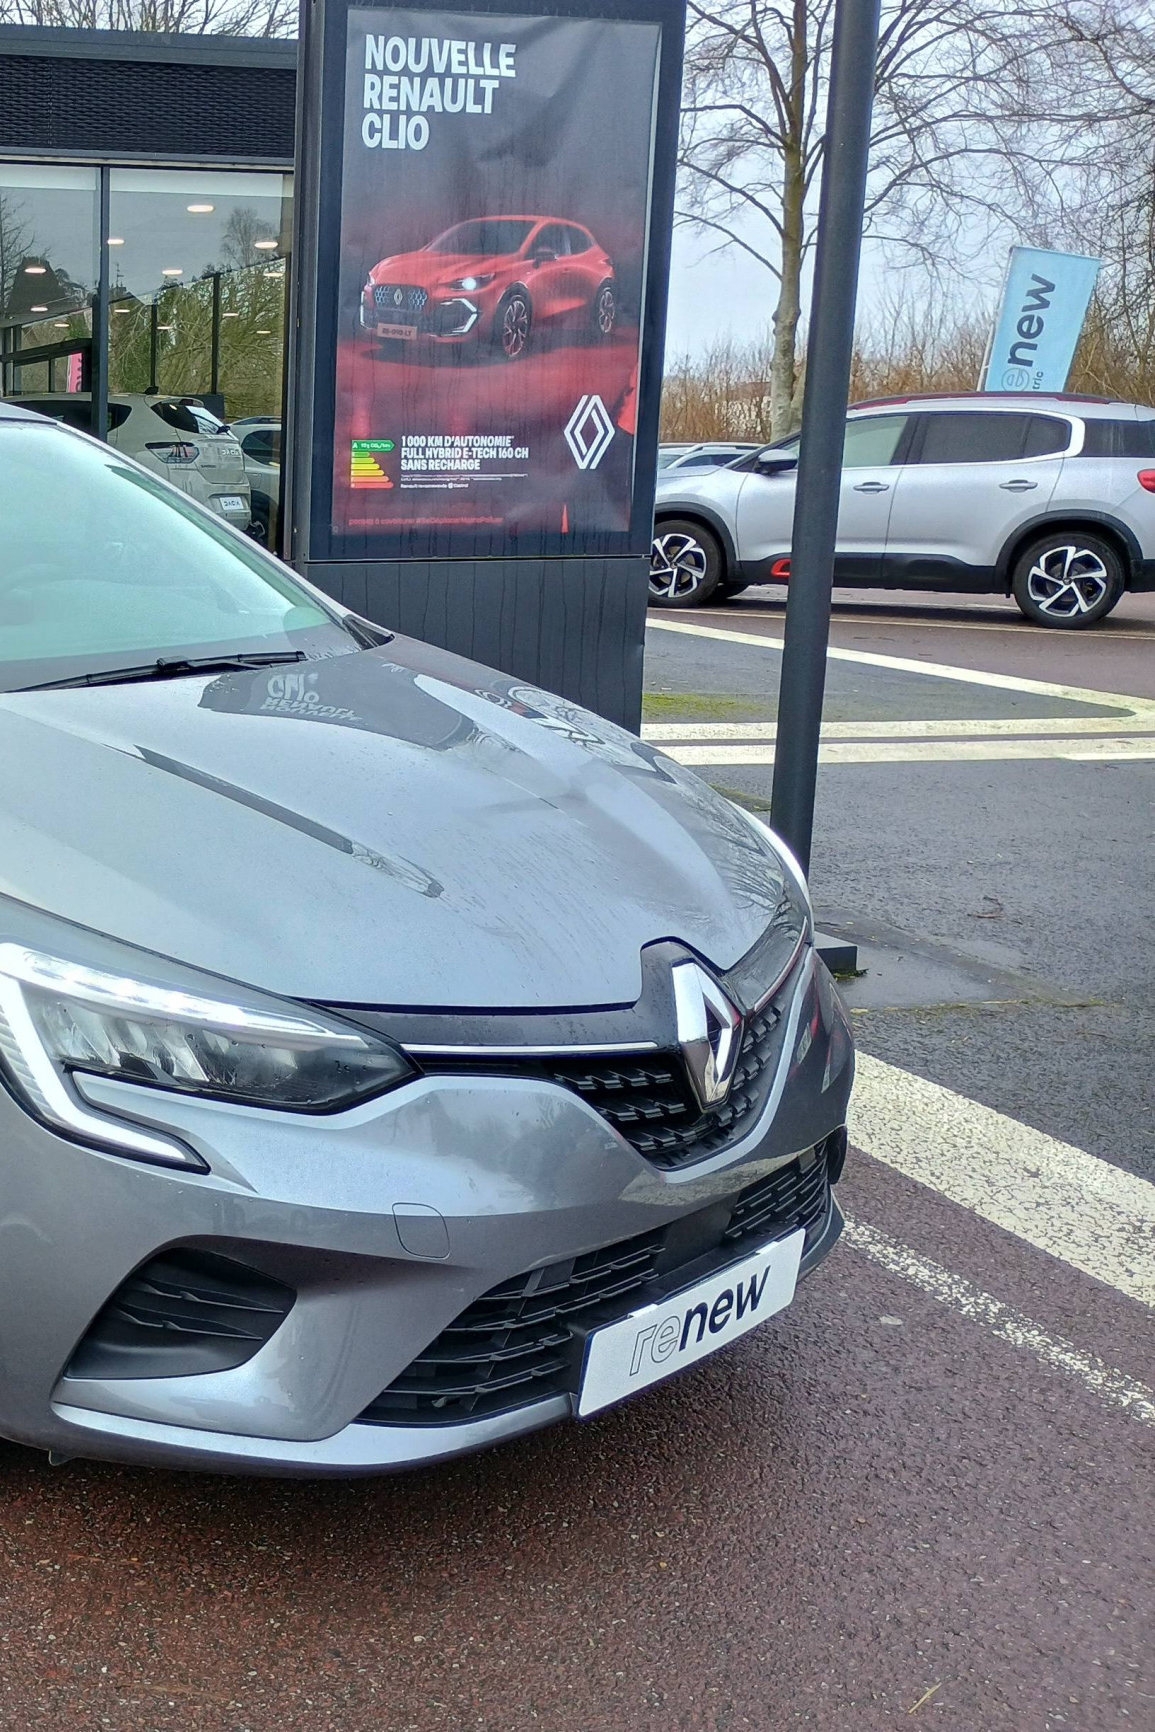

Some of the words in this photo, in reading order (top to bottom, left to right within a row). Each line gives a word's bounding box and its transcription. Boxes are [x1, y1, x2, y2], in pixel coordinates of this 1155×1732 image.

[364, 34, 517, 77] NOUVELLE
[363, 73, 500, 114] RENAULT
[361, 112, 430, 150] CLIO
[401, 447, 425, 458] FULL
[426, 447, 464, 458] HYBRID
[464, 447, 497, 458] E-TECH
[498, 447, 514, 458] 160
[515, 447, 529, 458] CH
[427, 436, 443, 447] KM
[401, 459, 427, 470] SANS
[428, 459, 480, 470] RECHARGE
[629, 1265, 772, 1377] renew
